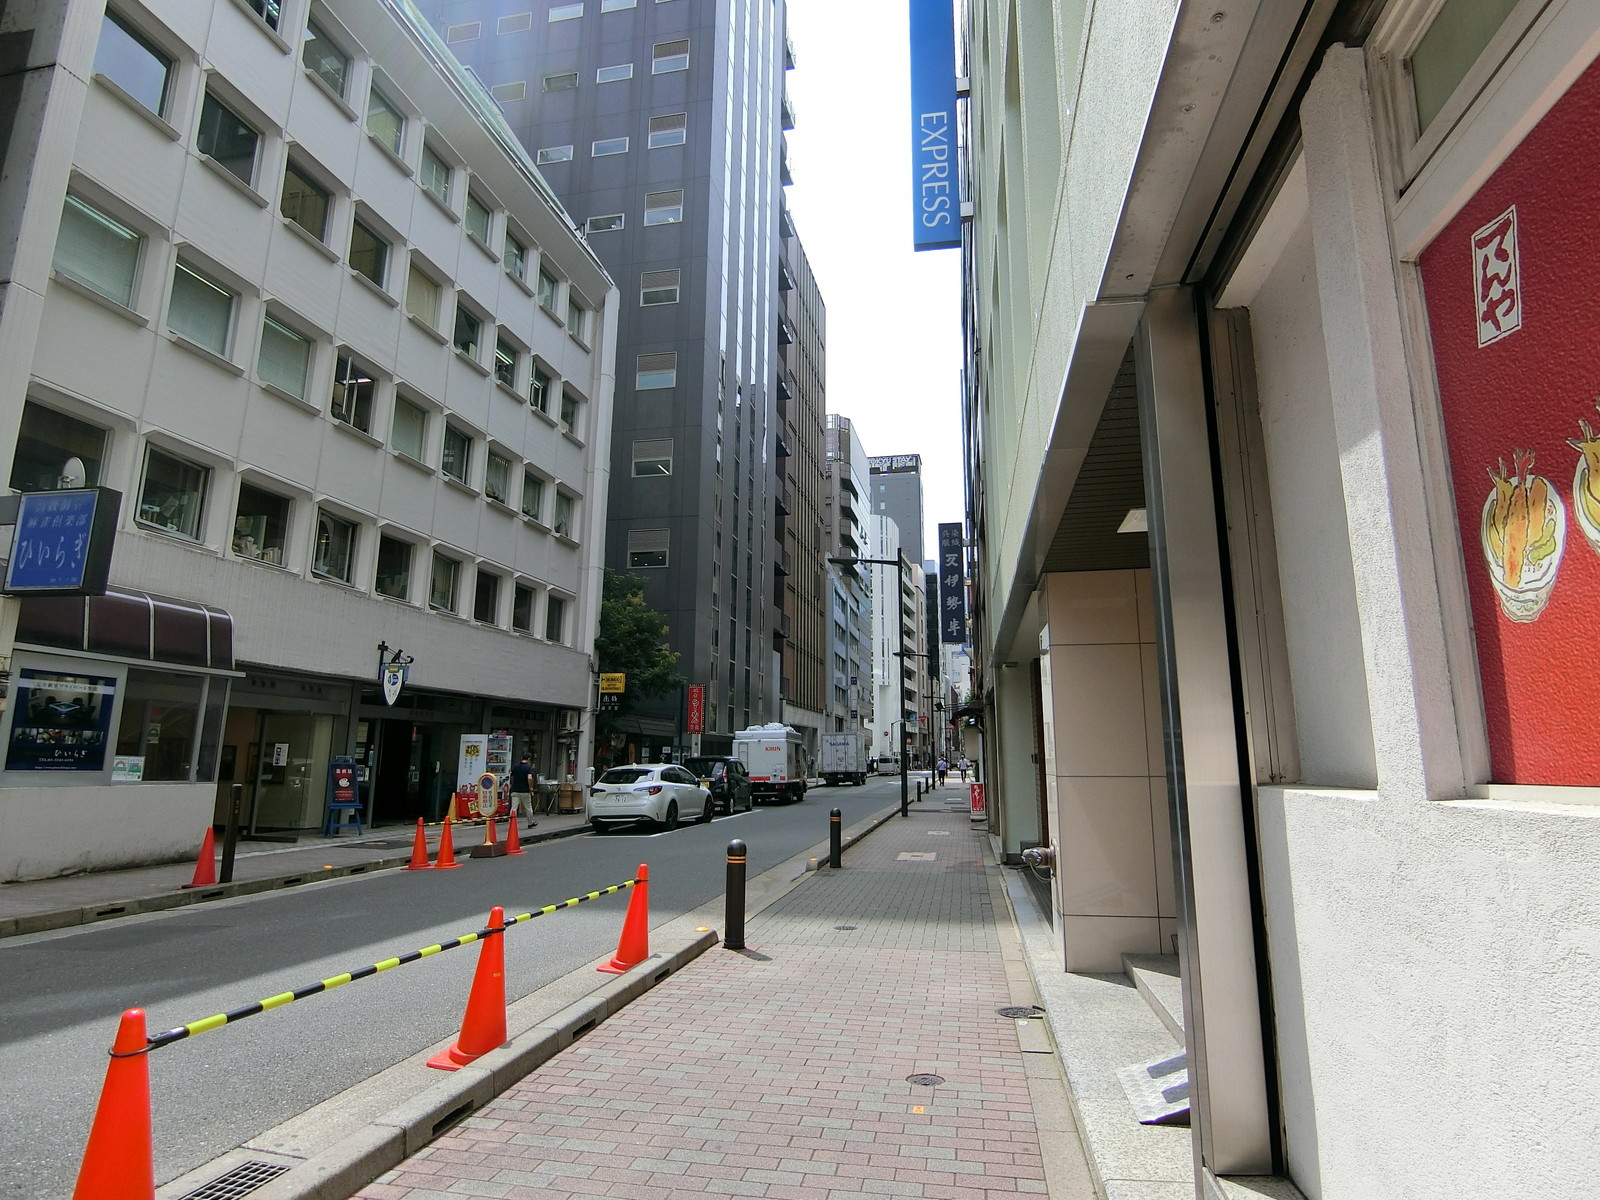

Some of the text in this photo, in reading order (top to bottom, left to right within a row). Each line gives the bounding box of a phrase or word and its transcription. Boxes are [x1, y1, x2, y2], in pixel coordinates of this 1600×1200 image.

[920, 111, 951, 228] EXPRESS
[1475, 216, 1516, 333] てんや
[891, 456, 911, 464] STAY
[18, 532, 87, 570] ひいらぎ
[54, 749, 88, 758] ひいらぎ
